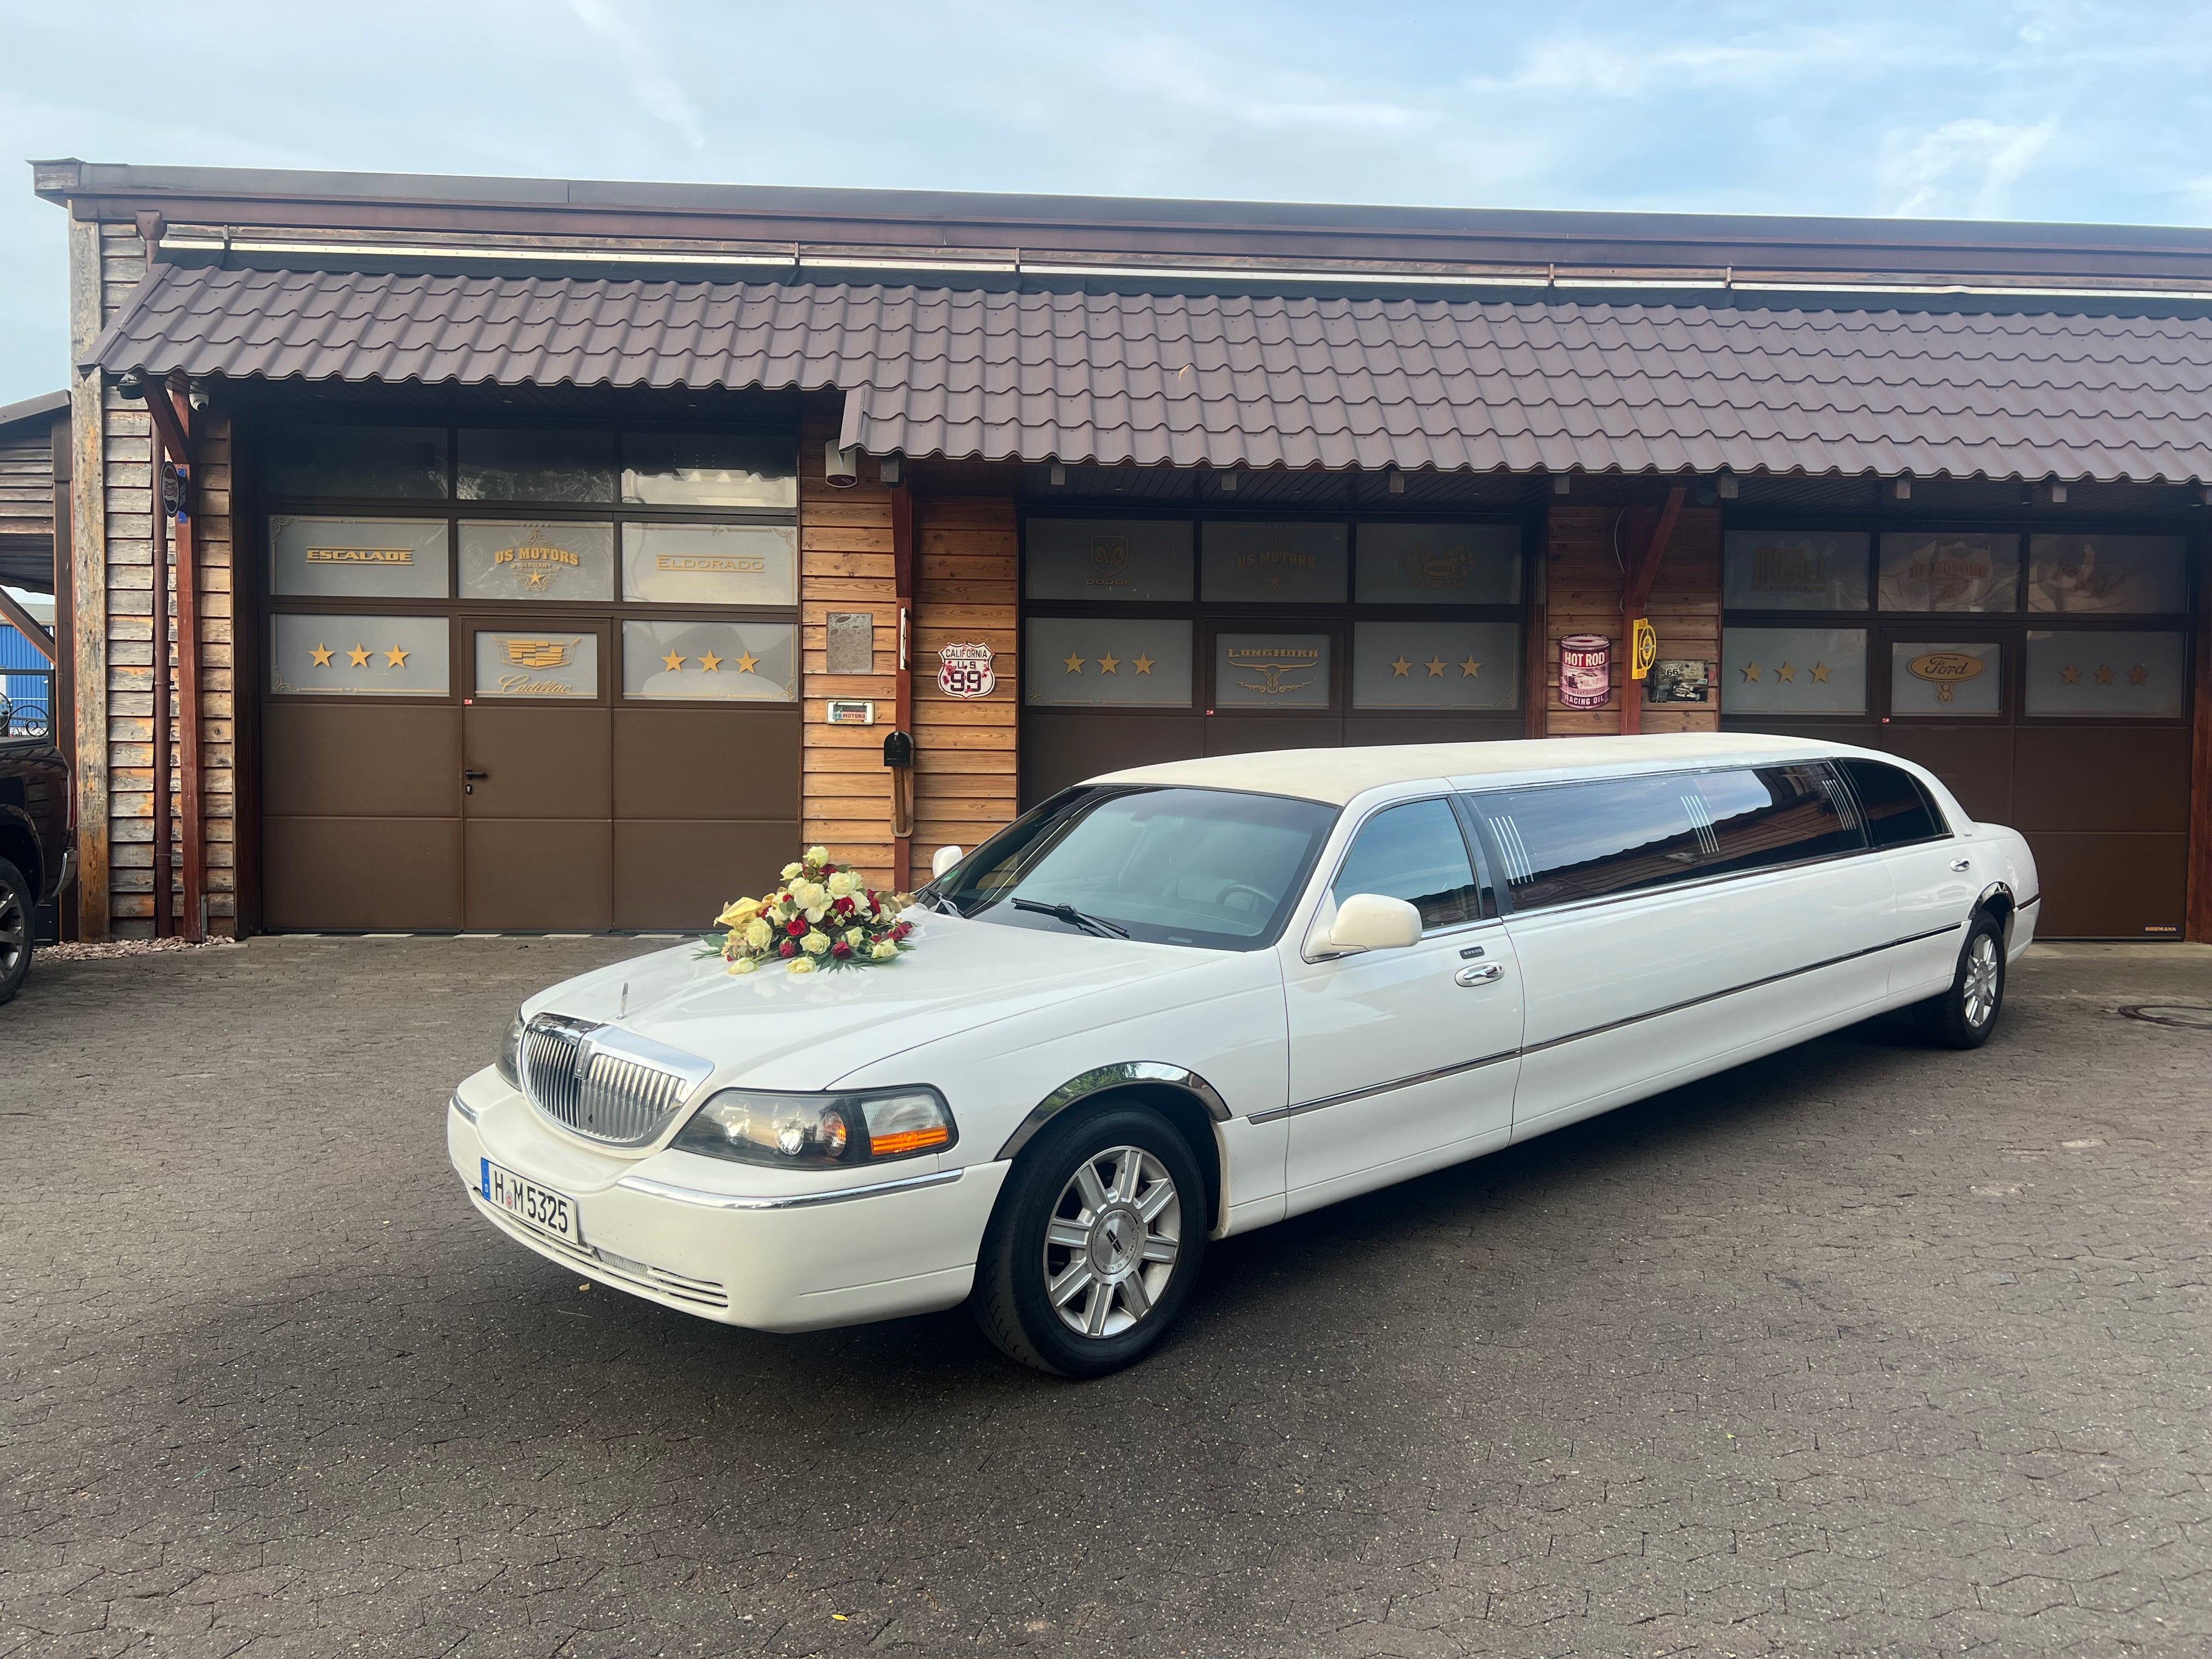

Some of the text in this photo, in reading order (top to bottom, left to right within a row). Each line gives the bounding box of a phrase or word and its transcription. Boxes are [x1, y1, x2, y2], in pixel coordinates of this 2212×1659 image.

[307, 549, 413, 562] ESCALADE
[495, 547, 580, 566] US MOTORS
[1237, 551, 1317, 569] US MOTORS
[656, 557, 764, 570] ELDORADO
[945, 649, 988, 658] CALIFORNIA
[1564, 652, 1605, 667] HOT ROD
[1925, 656, 1968, 669] Ford
[1666, 668, 1679, 676] 66
[498, 674, 572, 695] Cadillac
[950, 670, 981, 692] 99
[1564, 693, 1605, 706] RACING OIL
[484, 1183, 489, 1193] D
[494, 1170, 504, 1204] H
